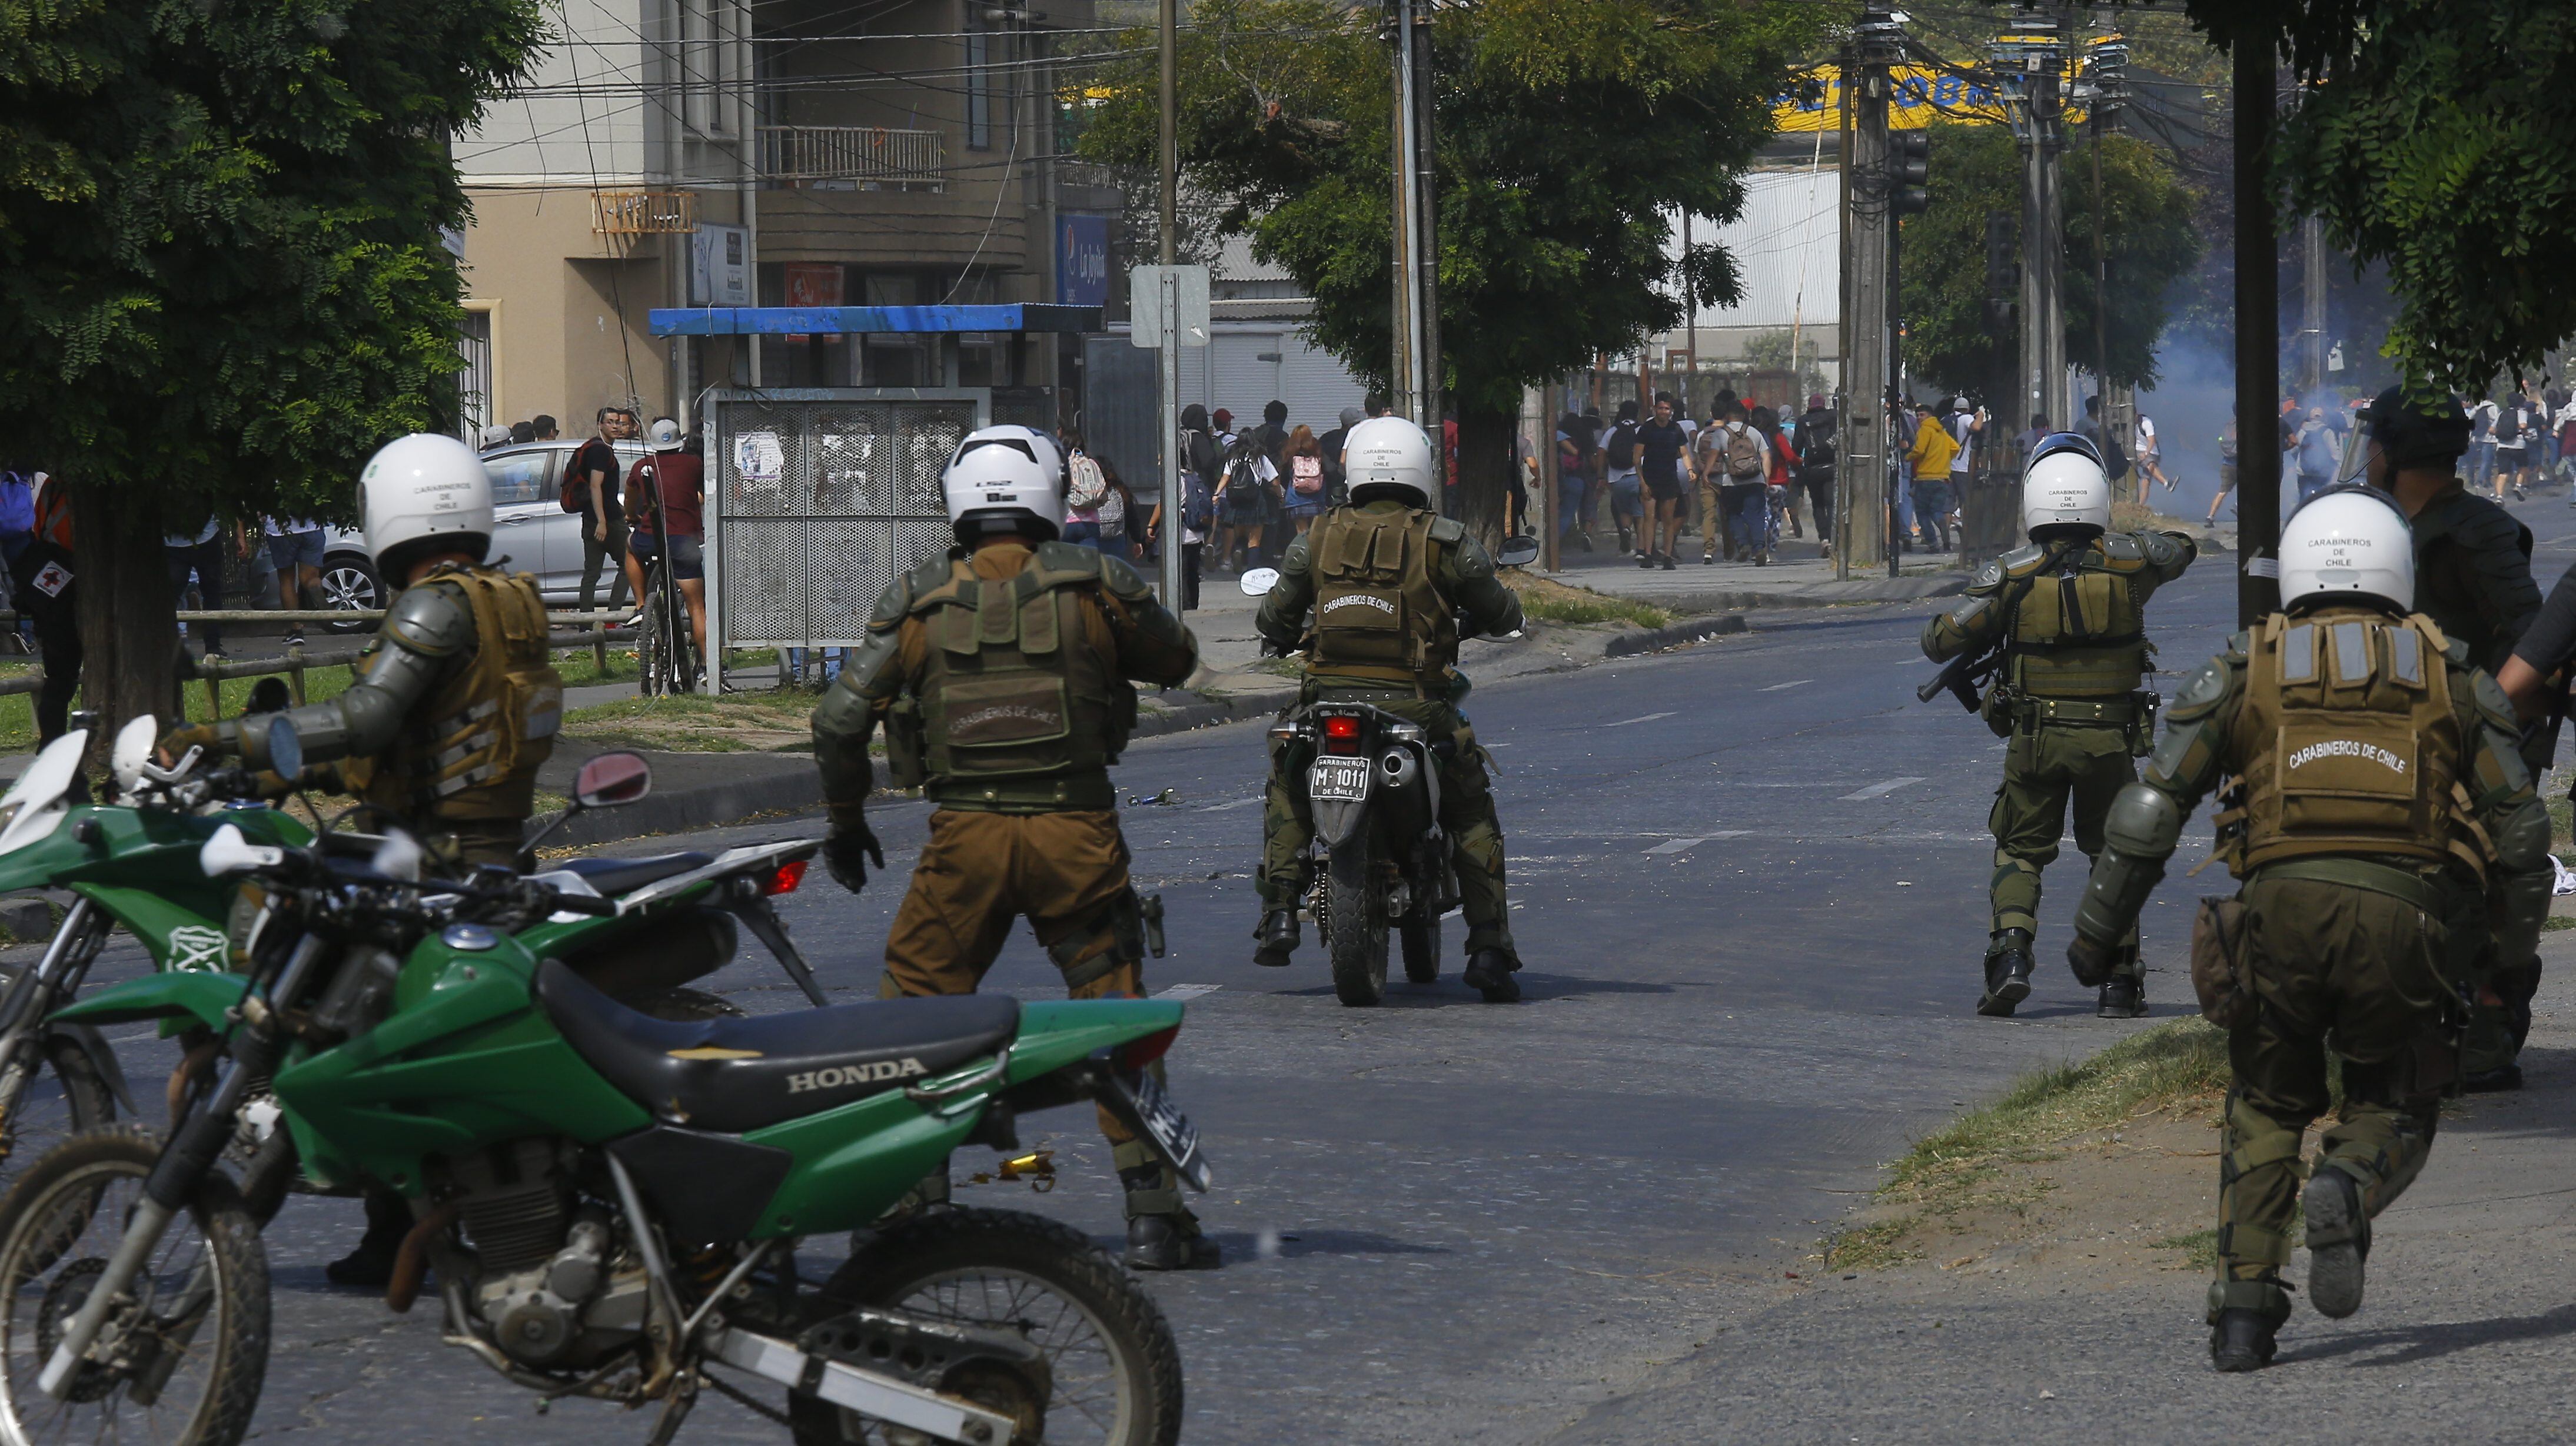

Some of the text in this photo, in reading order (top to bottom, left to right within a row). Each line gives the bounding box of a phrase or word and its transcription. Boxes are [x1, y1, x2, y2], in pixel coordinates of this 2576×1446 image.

[413, 483, 471, 494] CARABINEROS
[434, 502, 457, 510] CHILE
[2308, 538, 2371, 547] CARABINEROS
[1324, 595, 1394, 614] CARABINEROS DE CHILE
[1015, 706, 1028, 717] DE
[2289, 740, 2405, 773] CARABINEROS DE CHILE
[1318, 759, 1365, 767] CARABINEROS
[787, 1057, 929, 1093] HONDA
